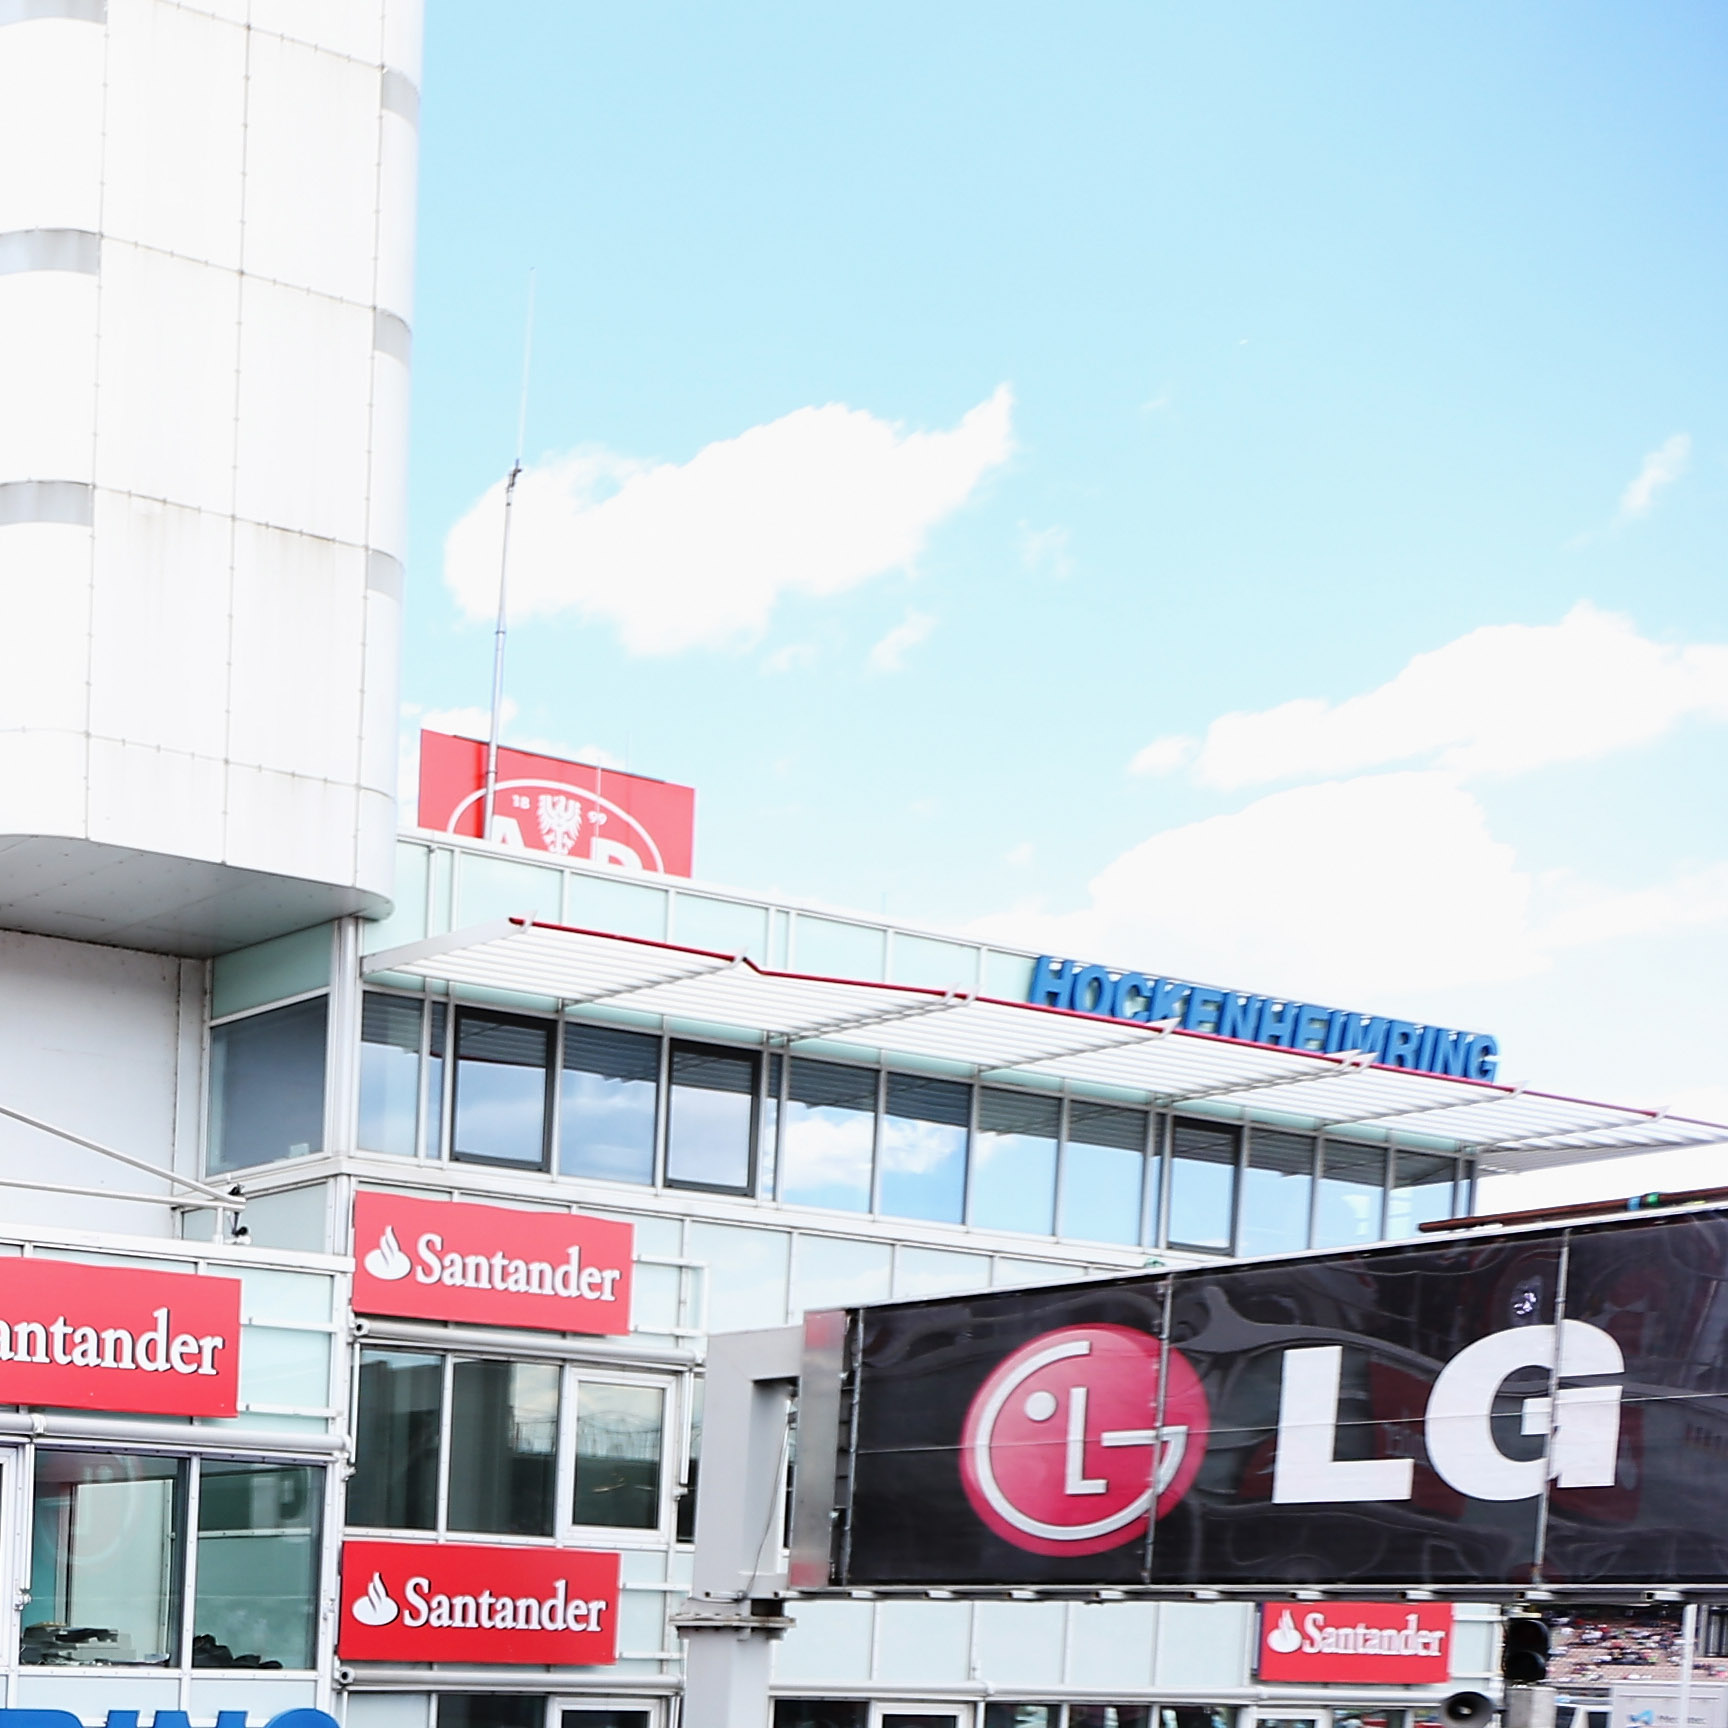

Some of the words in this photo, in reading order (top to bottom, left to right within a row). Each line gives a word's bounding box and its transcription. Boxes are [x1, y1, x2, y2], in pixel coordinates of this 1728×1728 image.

[512, 794, 530, 809] 18
[1029, 955, 1501, 1084] HOCKENHEIMRING
[415, 1233, 621, 1303] Santander
[1272, 1318, 1625, 1505] LG
[402, 1575, 607, 1633] Santander
[1301, 1611, 1446, 1657] Santander
